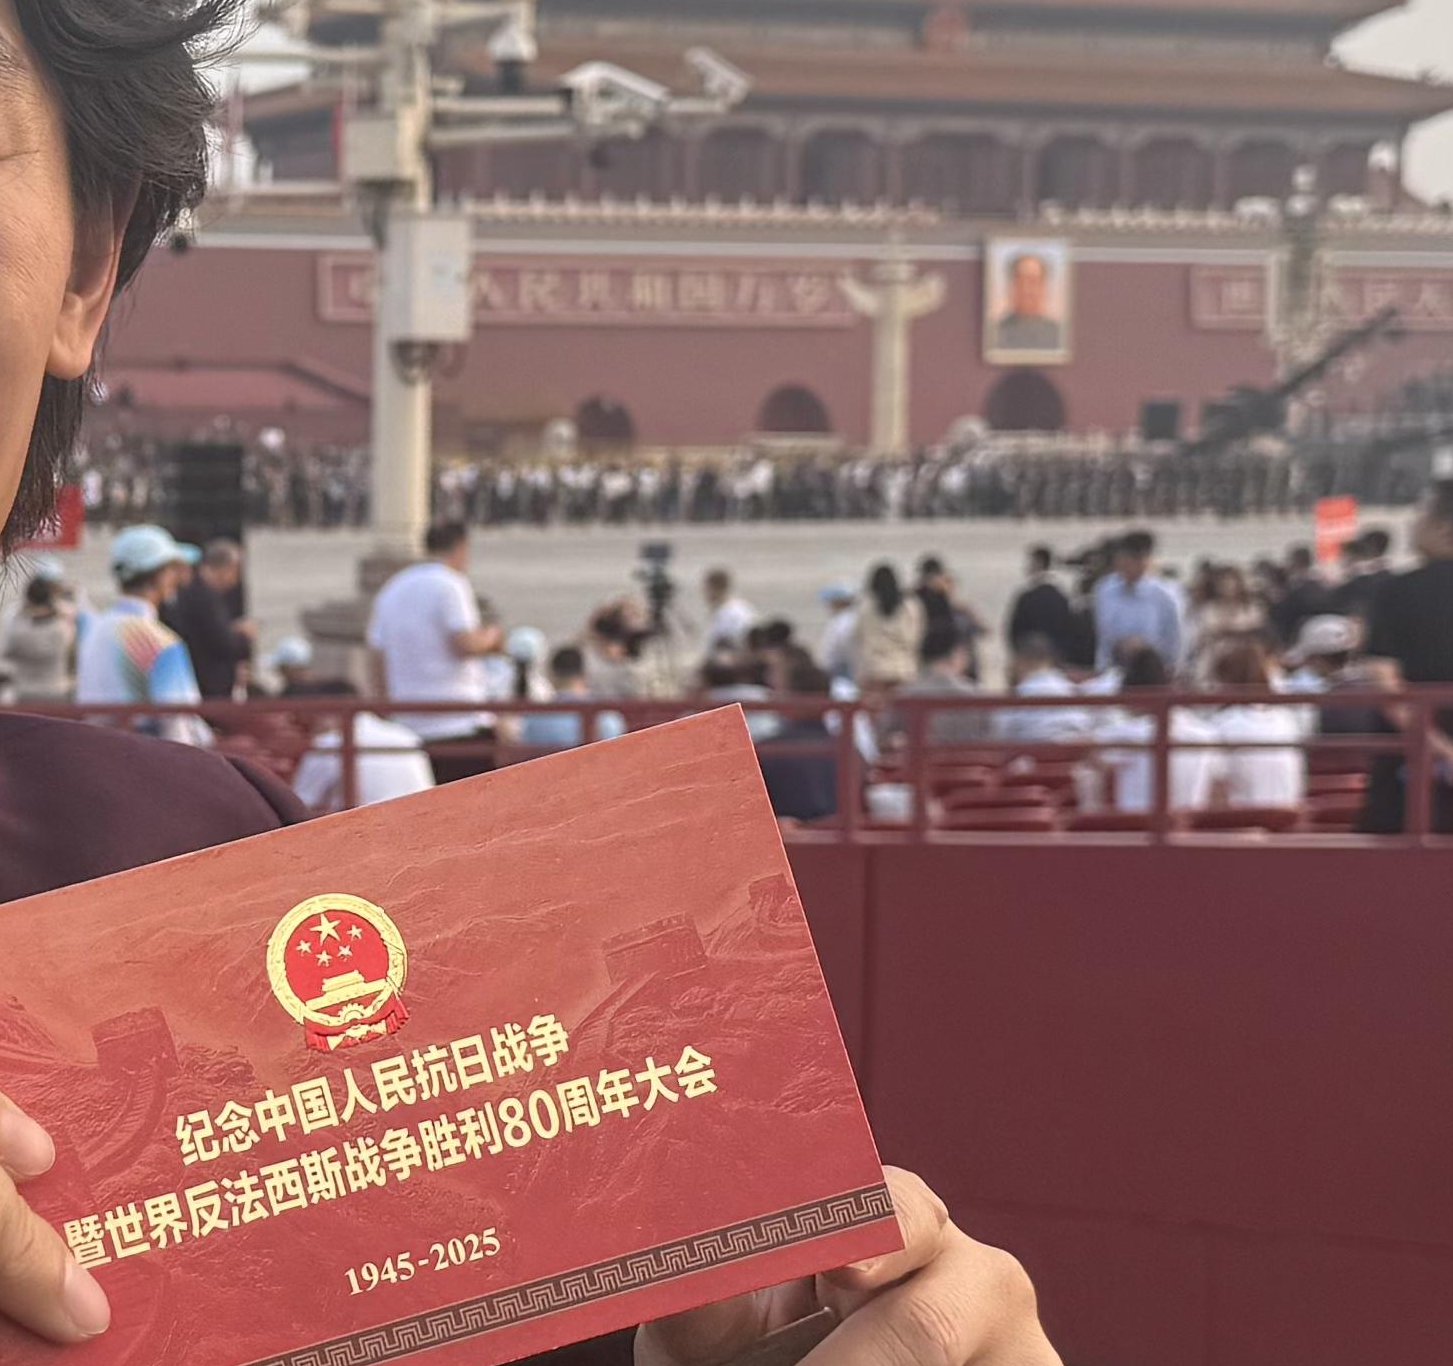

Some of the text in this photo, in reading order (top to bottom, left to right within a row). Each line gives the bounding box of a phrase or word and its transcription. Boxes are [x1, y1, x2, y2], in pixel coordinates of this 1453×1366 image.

[62, 1044, 718, 1270] 暨世界反法西斯战争胜利80周年大会
[175, 1013, 569, 1167] 纪念中国人民抗日战争
[344, 1226, 501, 1296] 1945-2025
